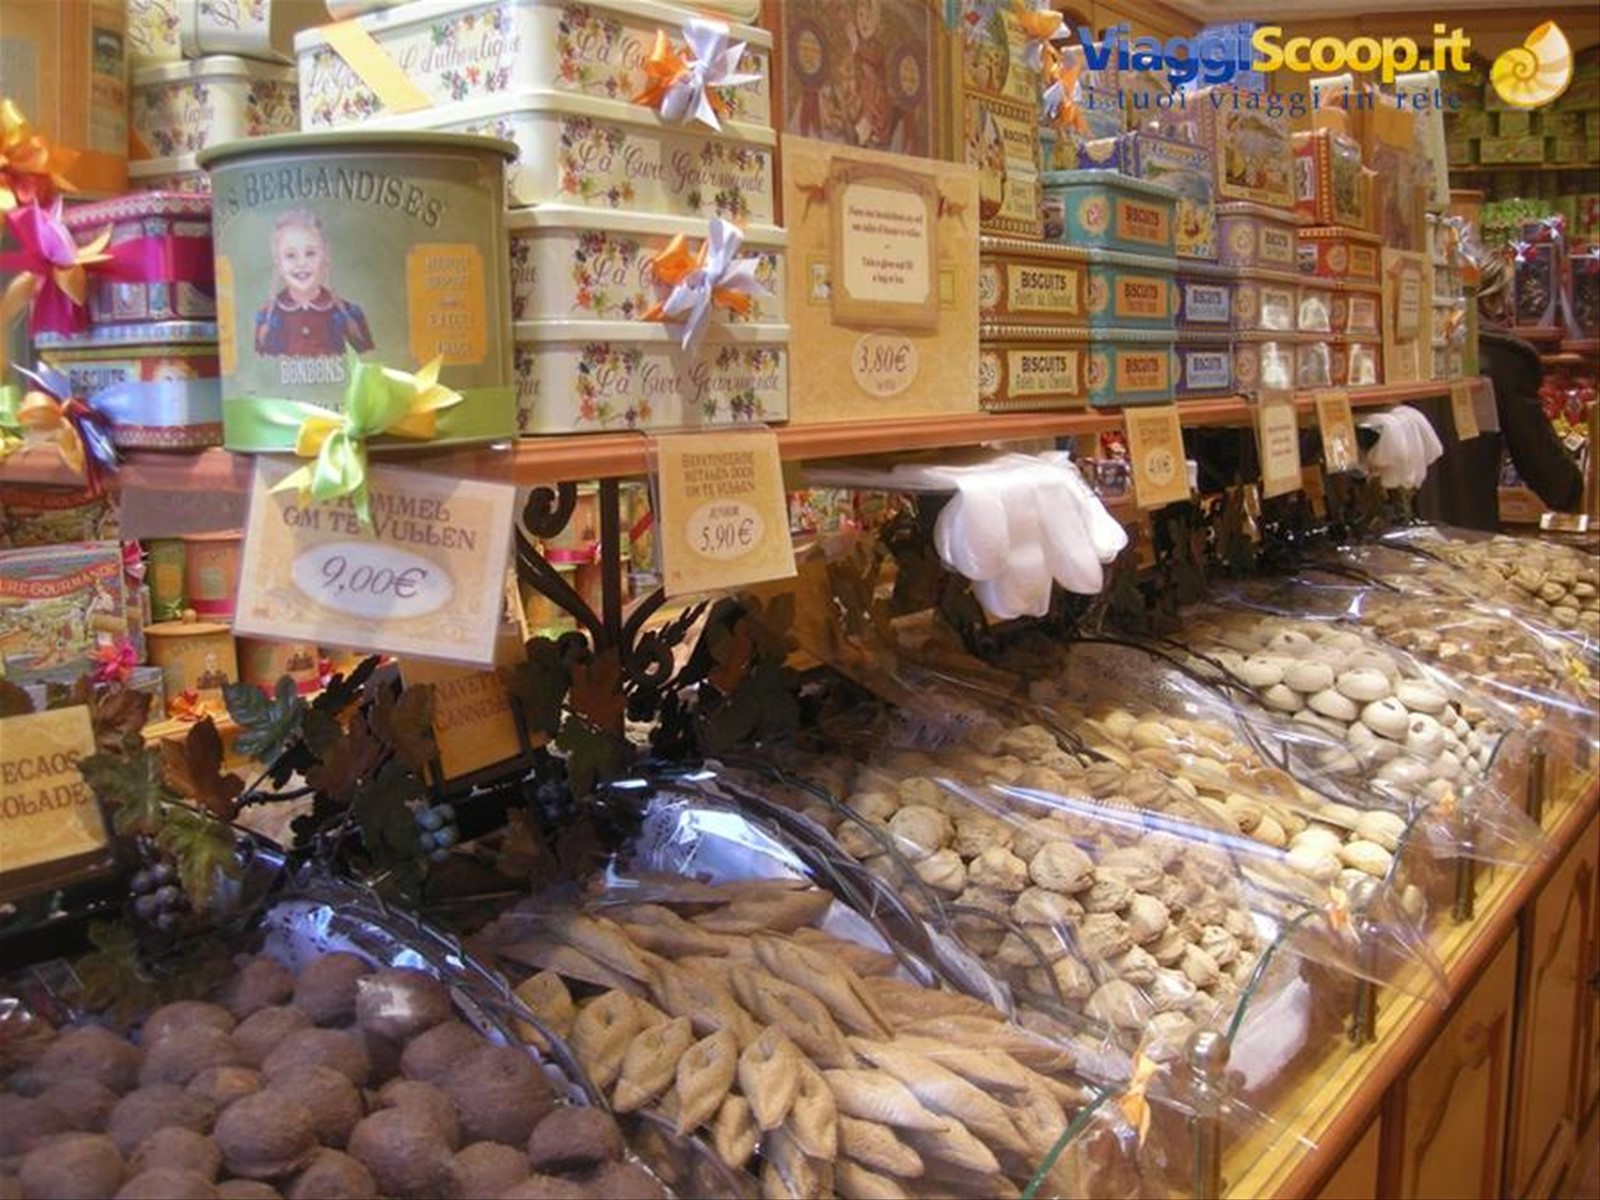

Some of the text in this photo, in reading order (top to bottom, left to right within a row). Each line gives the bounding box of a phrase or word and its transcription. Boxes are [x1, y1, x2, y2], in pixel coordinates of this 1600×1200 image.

[578, 140, 612, 172] La
[1021, 271, 1068, 291] BISCUITS
[281, 358, 345, 384] BONBONS
[1021, 355, 1068, 373] BISCUITS
[595, 364, 630, 398] La
[282, 505, 478, 550] OM TE VULLEN
